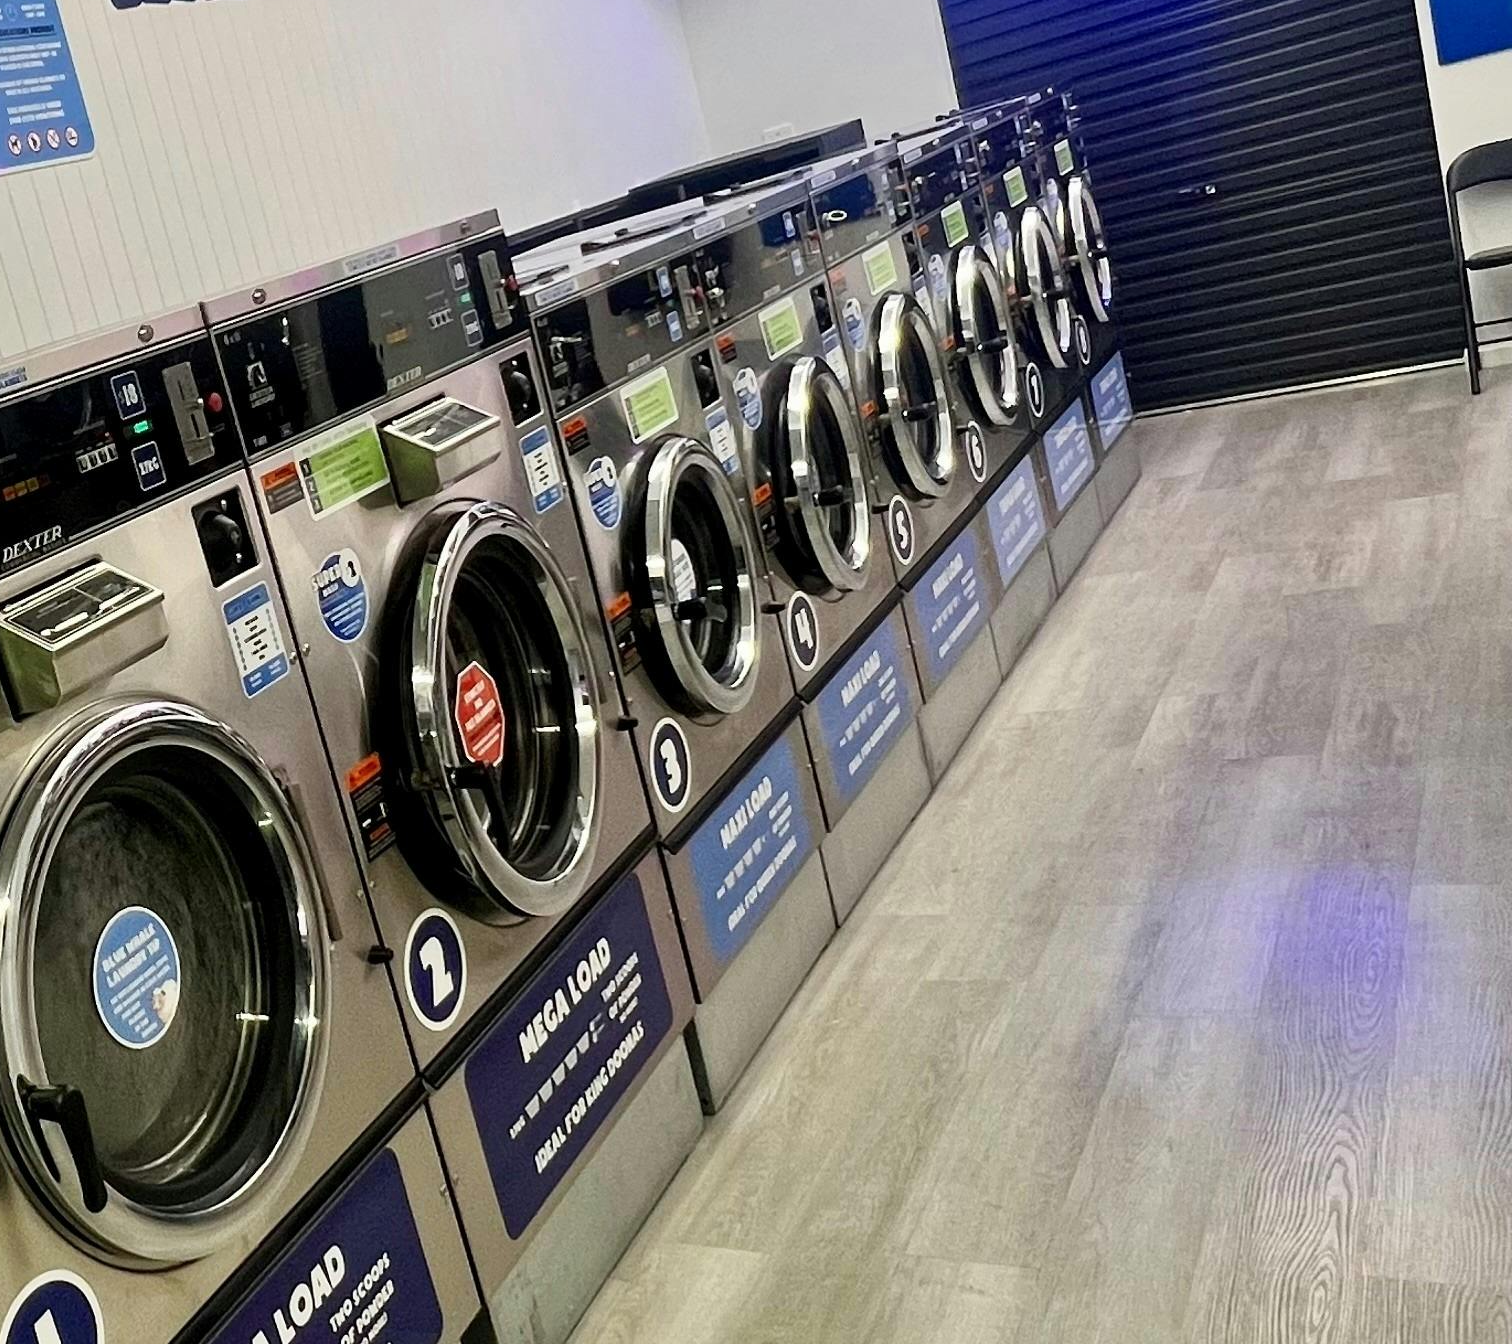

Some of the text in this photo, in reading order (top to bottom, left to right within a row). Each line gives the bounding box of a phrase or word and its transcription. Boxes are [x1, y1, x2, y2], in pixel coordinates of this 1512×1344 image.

[2, 524, 63, 564] DEXTER
[896, 508, 909, 550] 5
[795, 607, 814, 650] 4
[659, 737, 683, 795] 3
[418, 936, 454, 1008] 2
[518, 988, 571, 1064] MEGA
[566, 937, 611, 1005] LOAD
[534, 1126, 568, 1175] IDEAL
[564, 1095, 588, 1135] FOR
[584, 1066, 610, 1108] KING
[329, 1252, 390, 1333] TWO SCOOPS
[355, 1279, 395, 1334] POWDER
